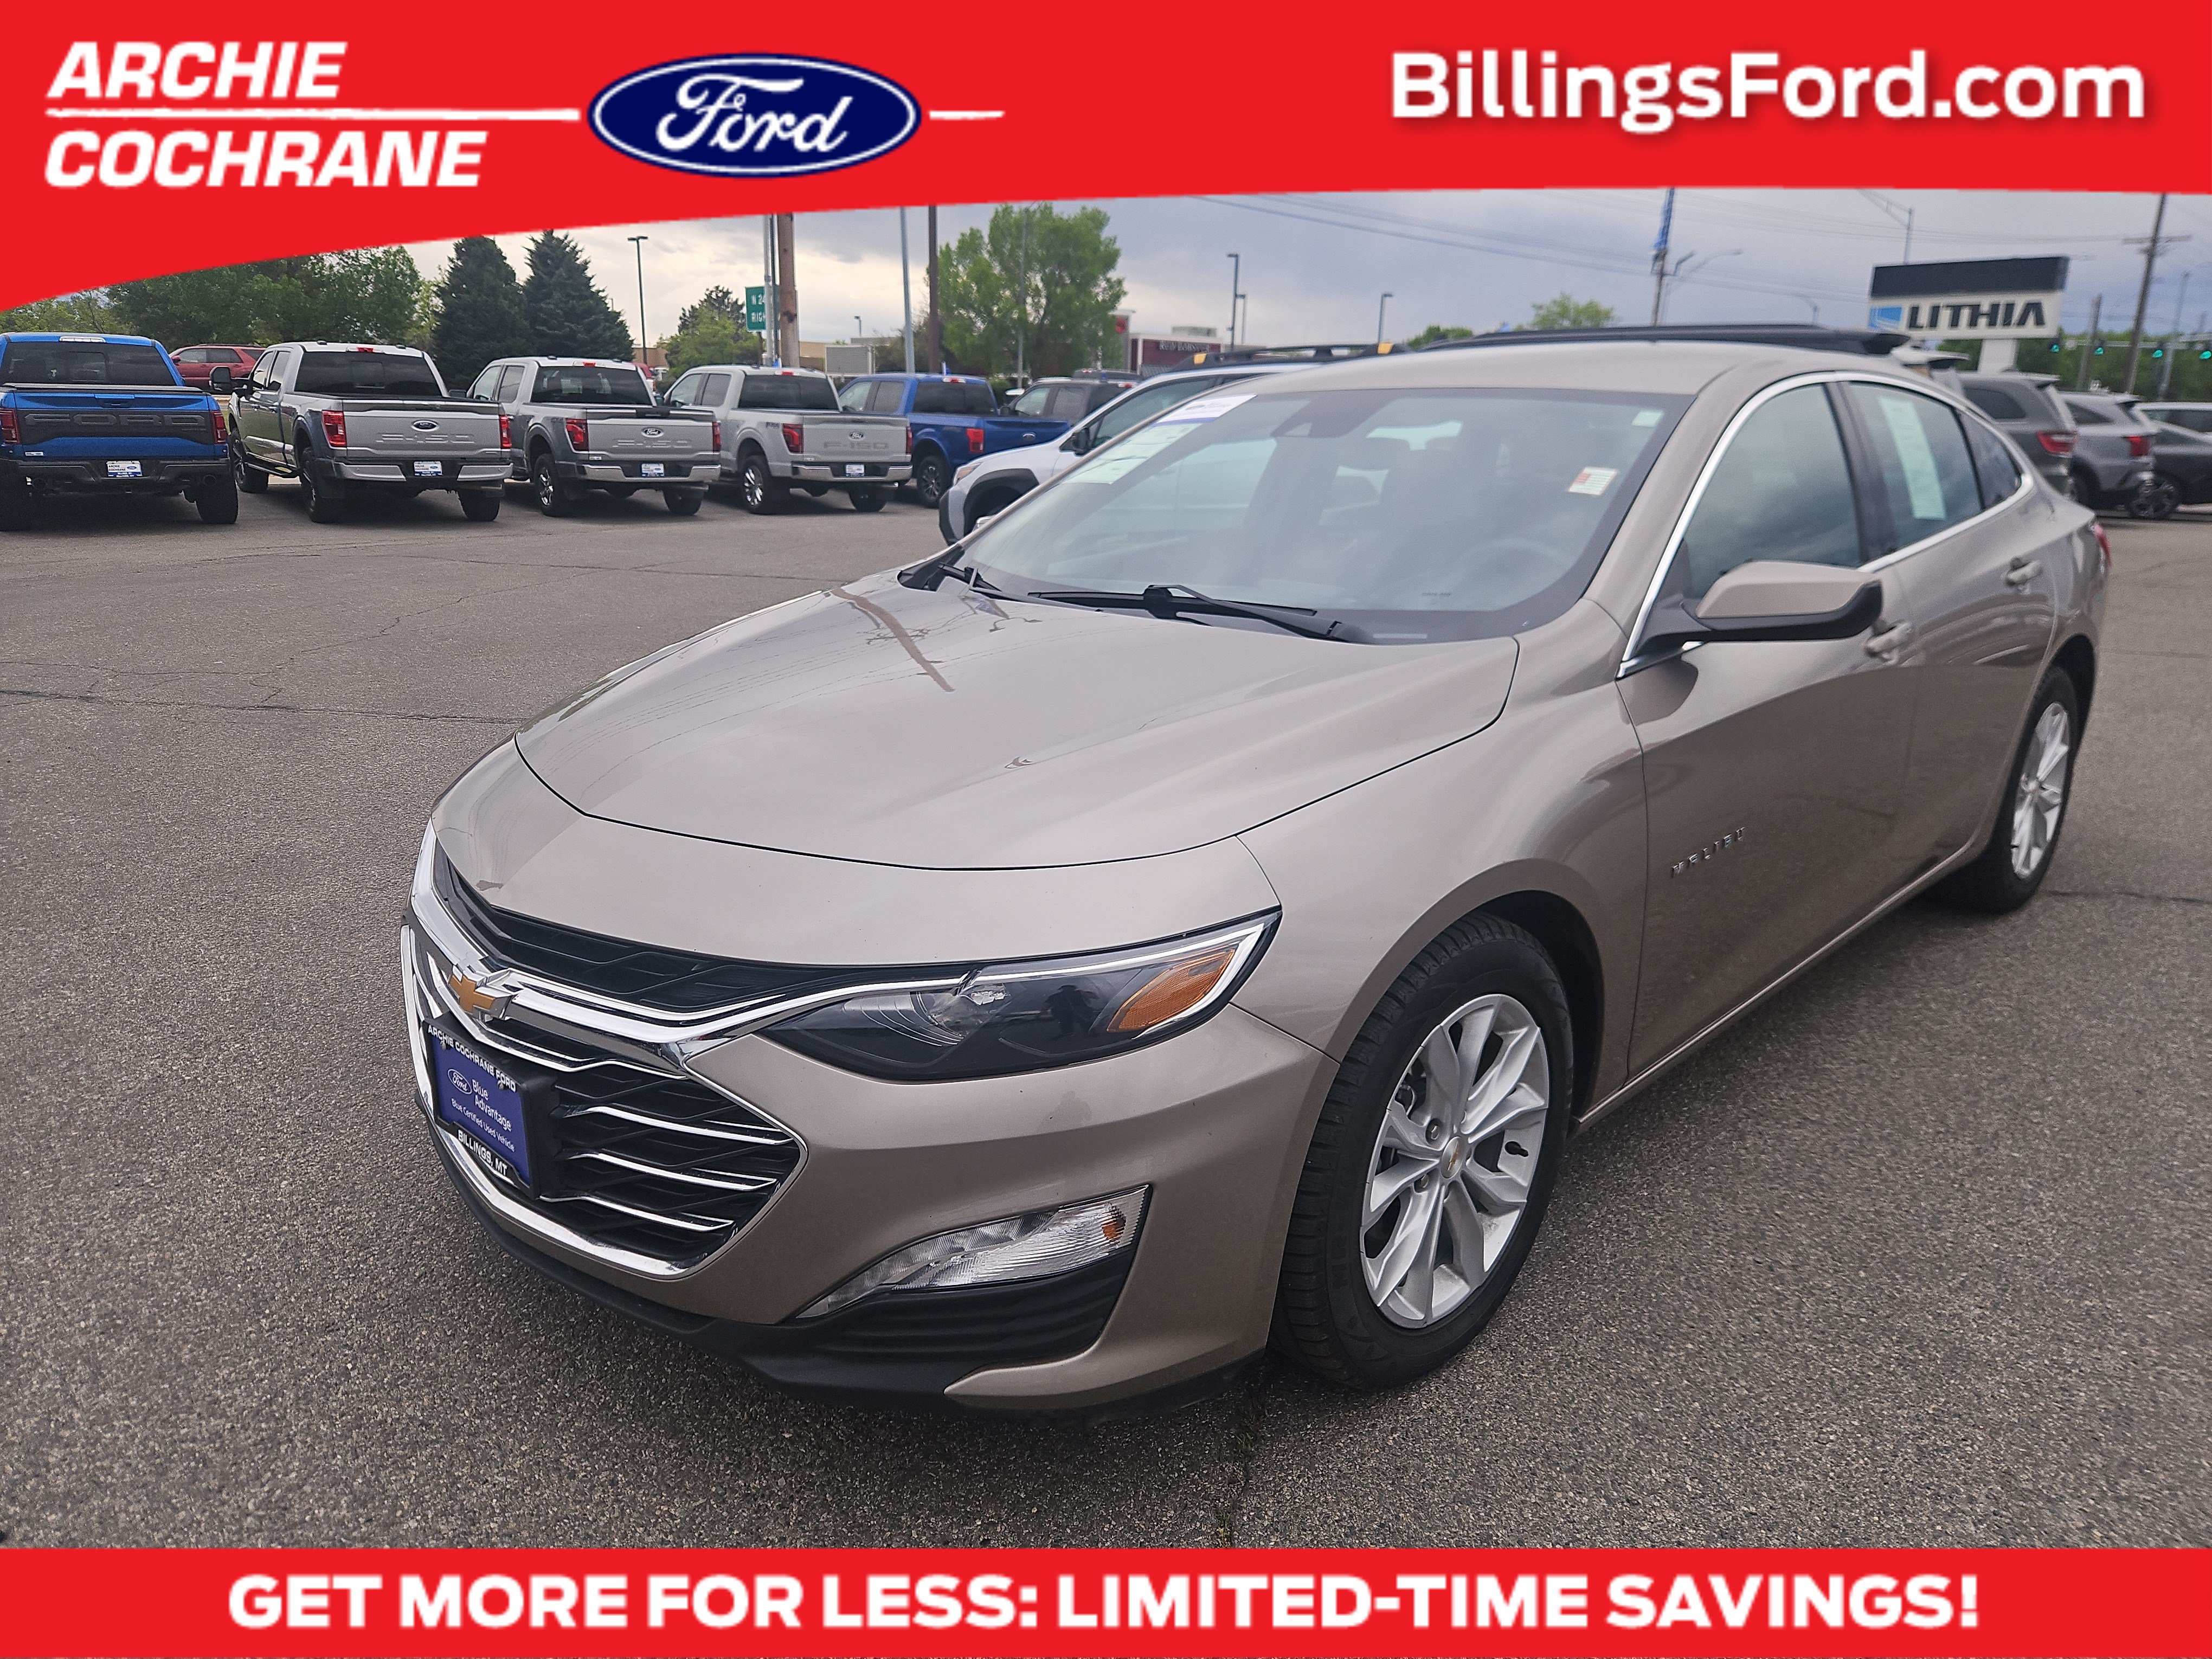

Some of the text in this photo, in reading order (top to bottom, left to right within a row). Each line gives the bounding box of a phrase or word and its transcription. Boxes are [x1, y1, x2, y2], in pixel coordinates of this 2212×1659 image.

[751, 312, 766, 323] RIGH
[1909, 302, 2045, 329] LITHIA
[24, 413, 205, 426] FORD
[455, 1041, 494, 1076] COCHRANE
[496, 1069, 516, 1093] FORD
[472, 1078, 489, 1101] Blue
[451, 1097, 516, 1153] Blue Certified Used Vehicle
[474, 1096, 512, 1132] Advantage
[458, 1129, 508, 1176] BILLINGS, MT
